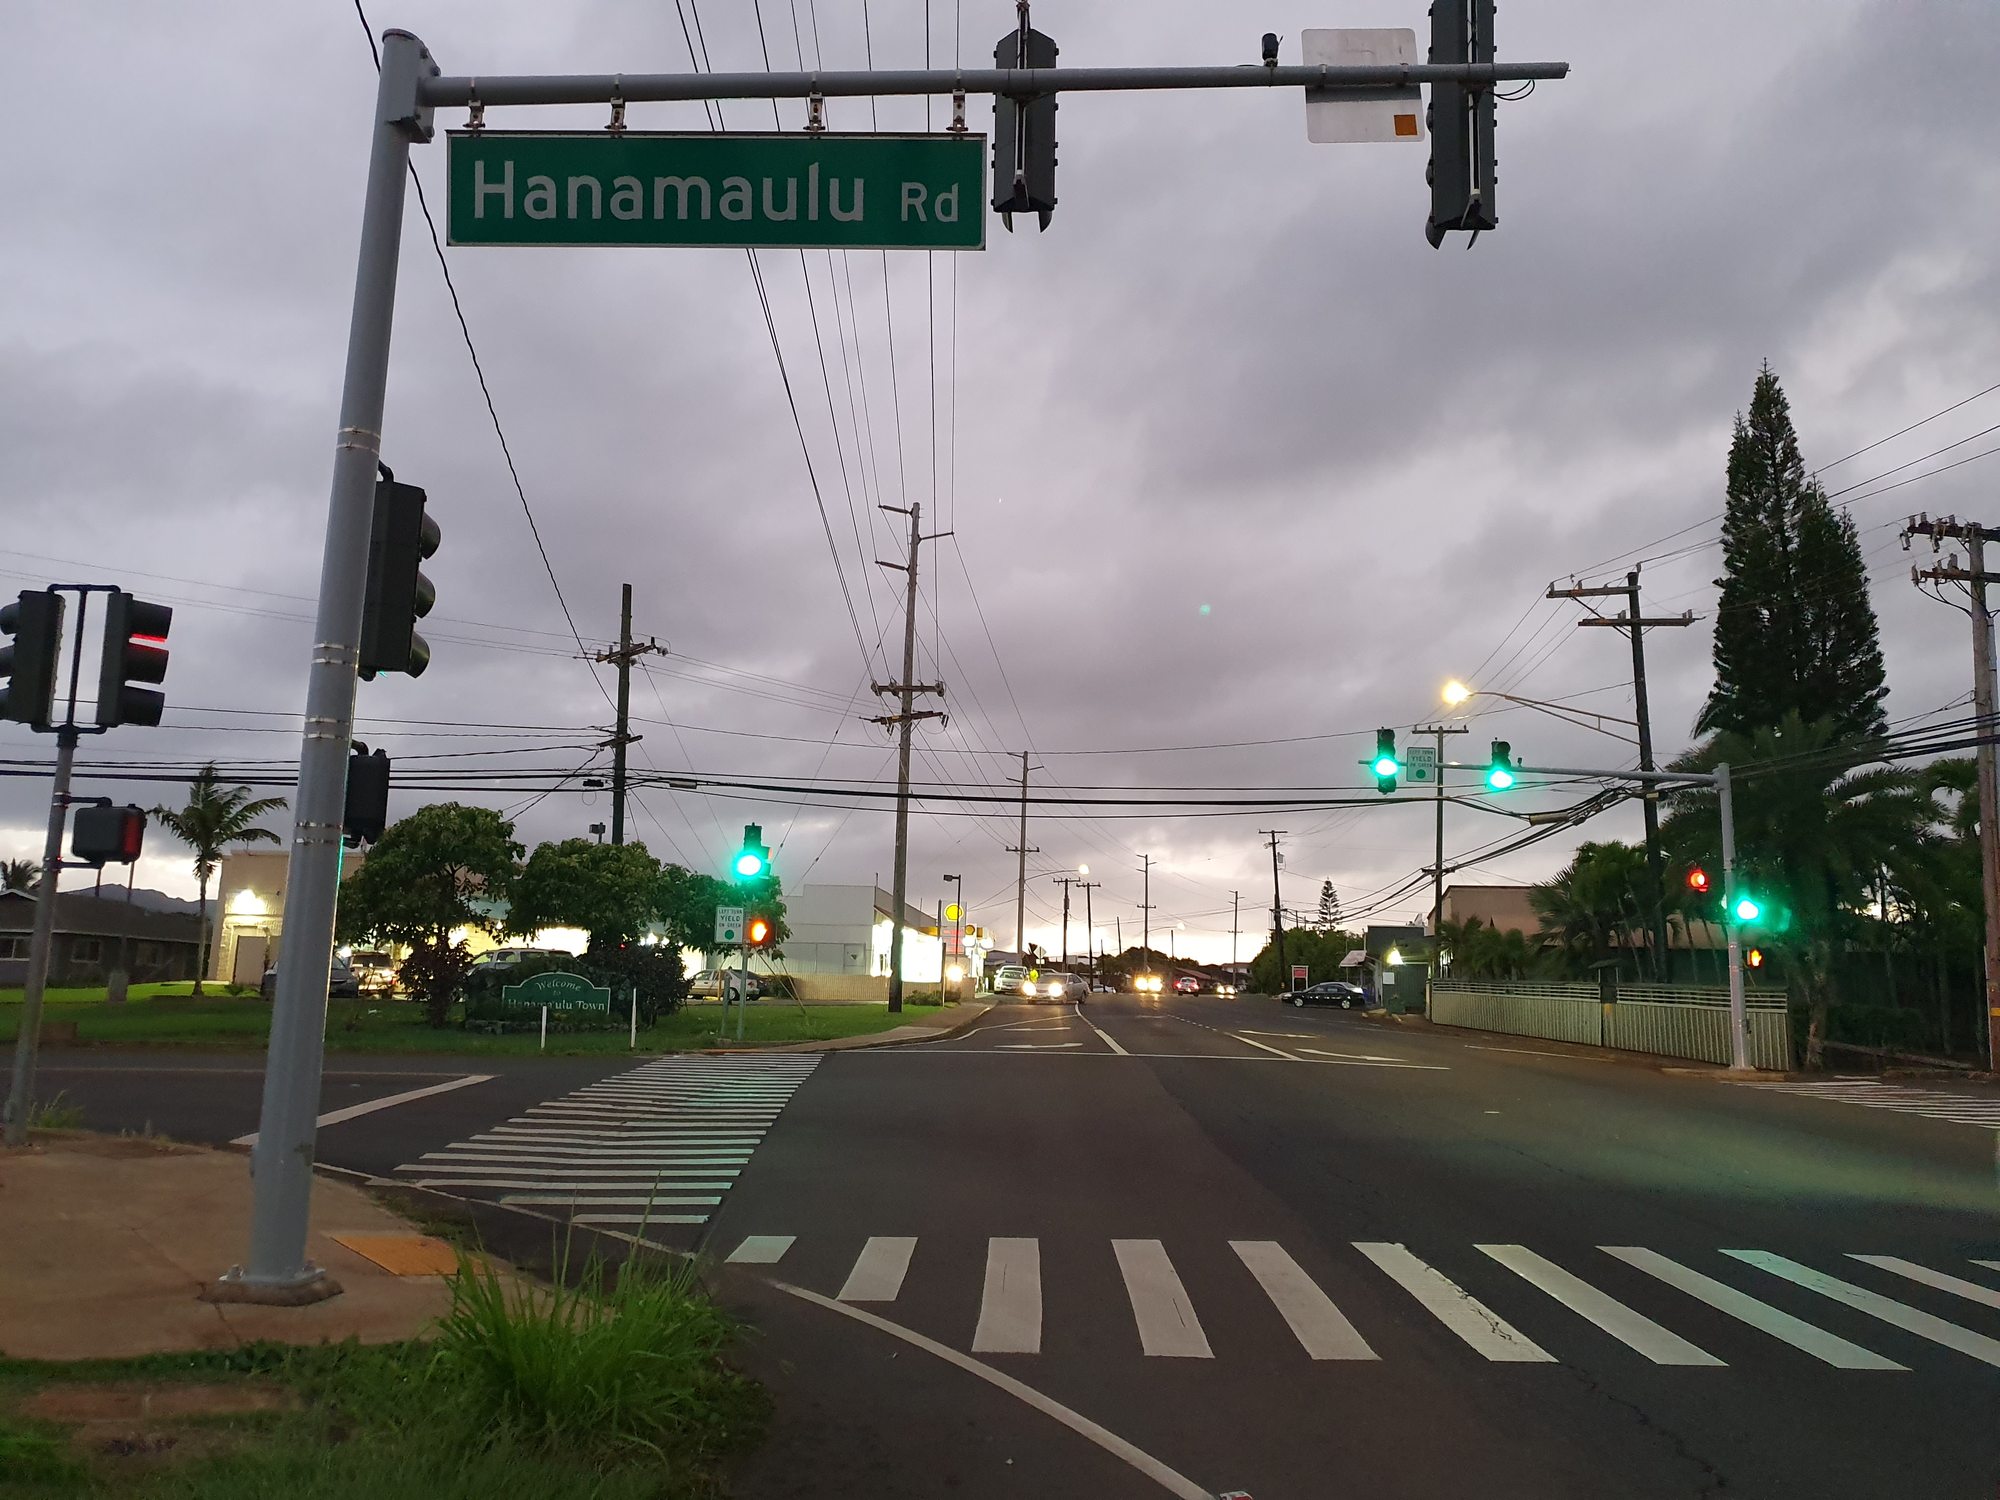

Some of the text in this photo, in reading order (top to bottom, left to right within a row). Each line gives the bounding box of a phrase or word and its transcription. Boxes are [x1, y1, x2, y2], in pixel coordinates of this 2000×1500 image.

[473, 160, 960, 223] Hanamaulu Rd
[535, 978, 581, 991] Welcome
[575, 1000, 605, 1011] Town
